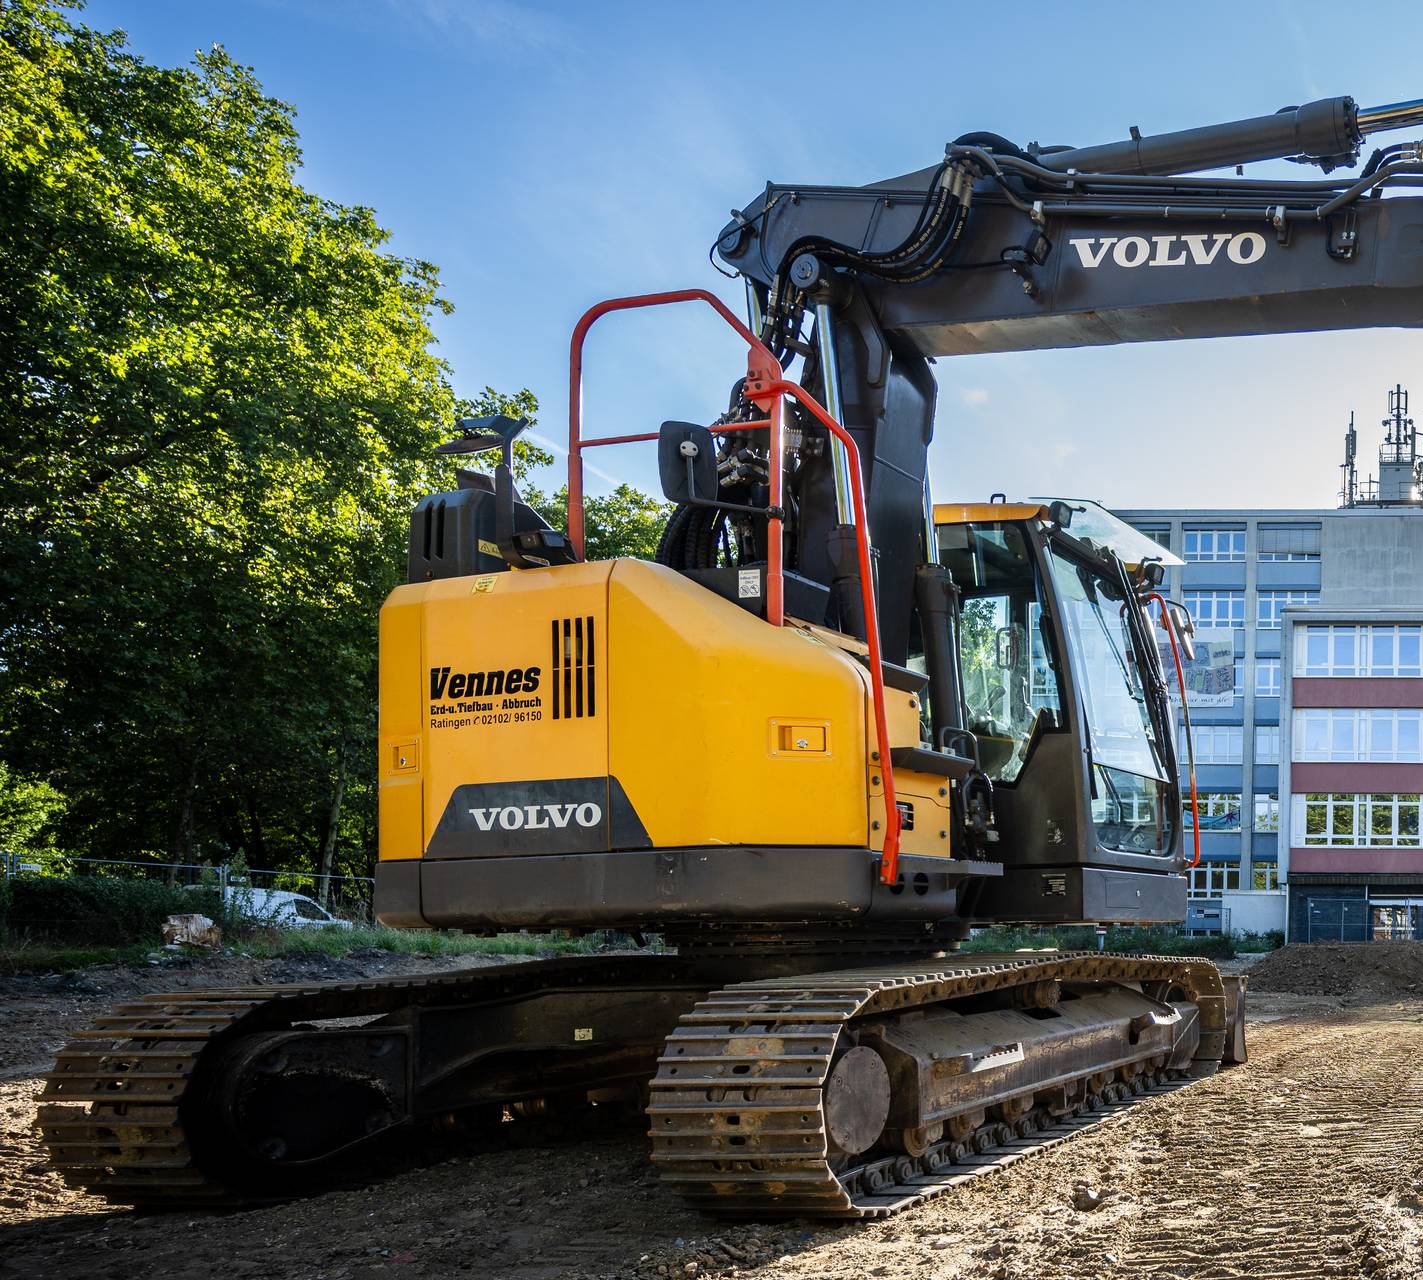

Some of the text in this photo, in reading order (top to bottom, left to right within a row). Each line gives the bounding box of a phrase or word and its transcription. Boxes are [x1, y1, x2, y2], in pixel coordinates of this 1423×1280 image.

[1069, 232, 1267, 268] VOLVO
[430, 666, 541, 700] Vennes
[502, 696, 541, 709] Abbruch
[430, 710, 542, 729] Ratingen 02102/ 96150
[469, 802, 602, 831] VOLVO
